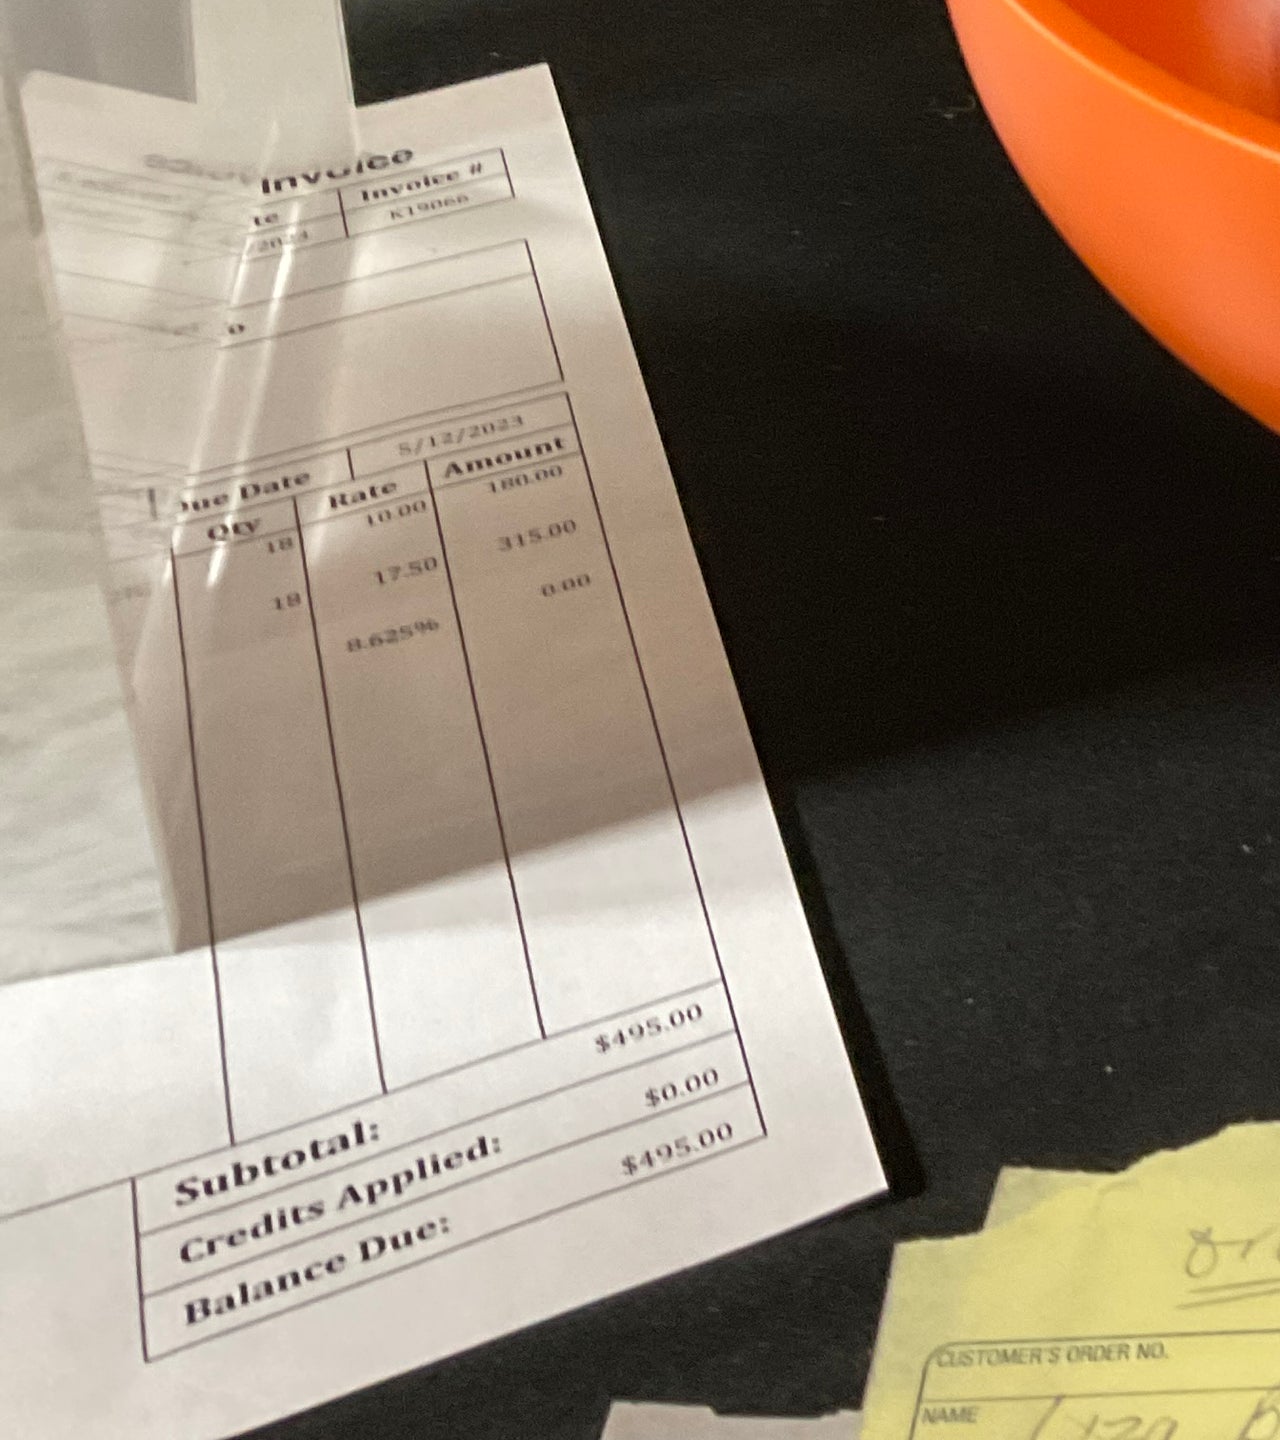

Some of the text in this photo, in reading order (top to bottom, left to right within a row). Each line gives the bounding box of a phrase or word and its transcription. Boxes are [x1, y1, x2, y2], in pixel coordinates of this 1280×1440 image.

[361, 169, 460, 202] Invoice
[207, 436, 566, 544] Qty Rate Amount
[240, 472, 311, 501] Date
[398, 414, 524, 457] 5/12/2023
[366, 499, 427, 528] 10.00
[488, 464, 564, 494] 180.00
[275, 518, 578, 611] 18 17.50 315.00
[346, 572, 592, 653] 8.625% 0.00
[175, 1002, 703, 1207] Subtotal: $495.00
[178, 1067, 720, 1264] Credits Applied: $0.00
[183, 1121, 734, 1326] Balance Due: $495.00
[936, 1340, 1170, 1368] CUSTOMER'S ORDER NO.
[921, 1404, 978, 1426] NAME
